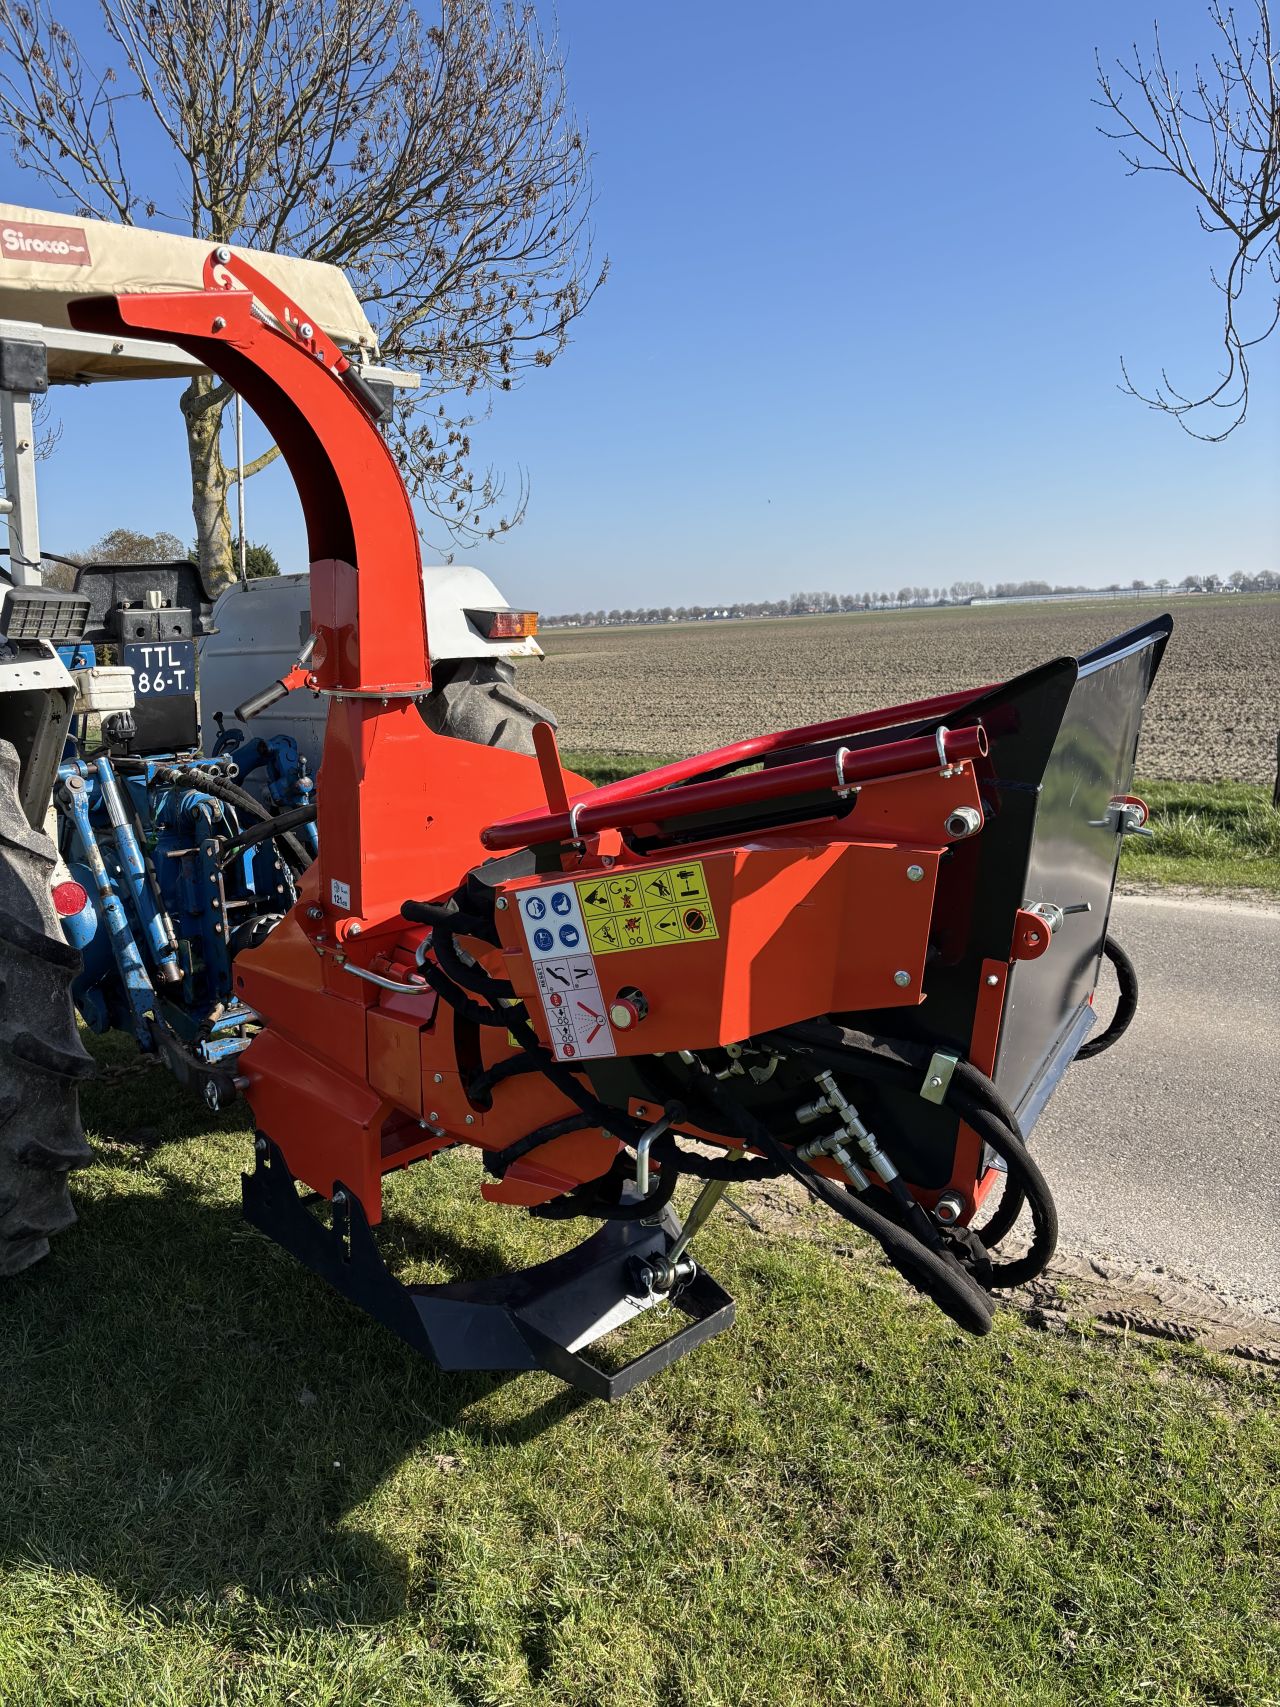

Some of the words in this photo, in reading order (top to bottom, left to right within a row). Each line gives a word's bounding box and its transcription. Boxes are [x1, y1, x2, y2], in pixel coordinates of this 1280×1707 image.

[2, 228, 70, 255] Sirocco
[140, 645, 181, 668] TTL
[138, 669, 186, 693] 86-T
[537, 967, 546, 988] RESET
